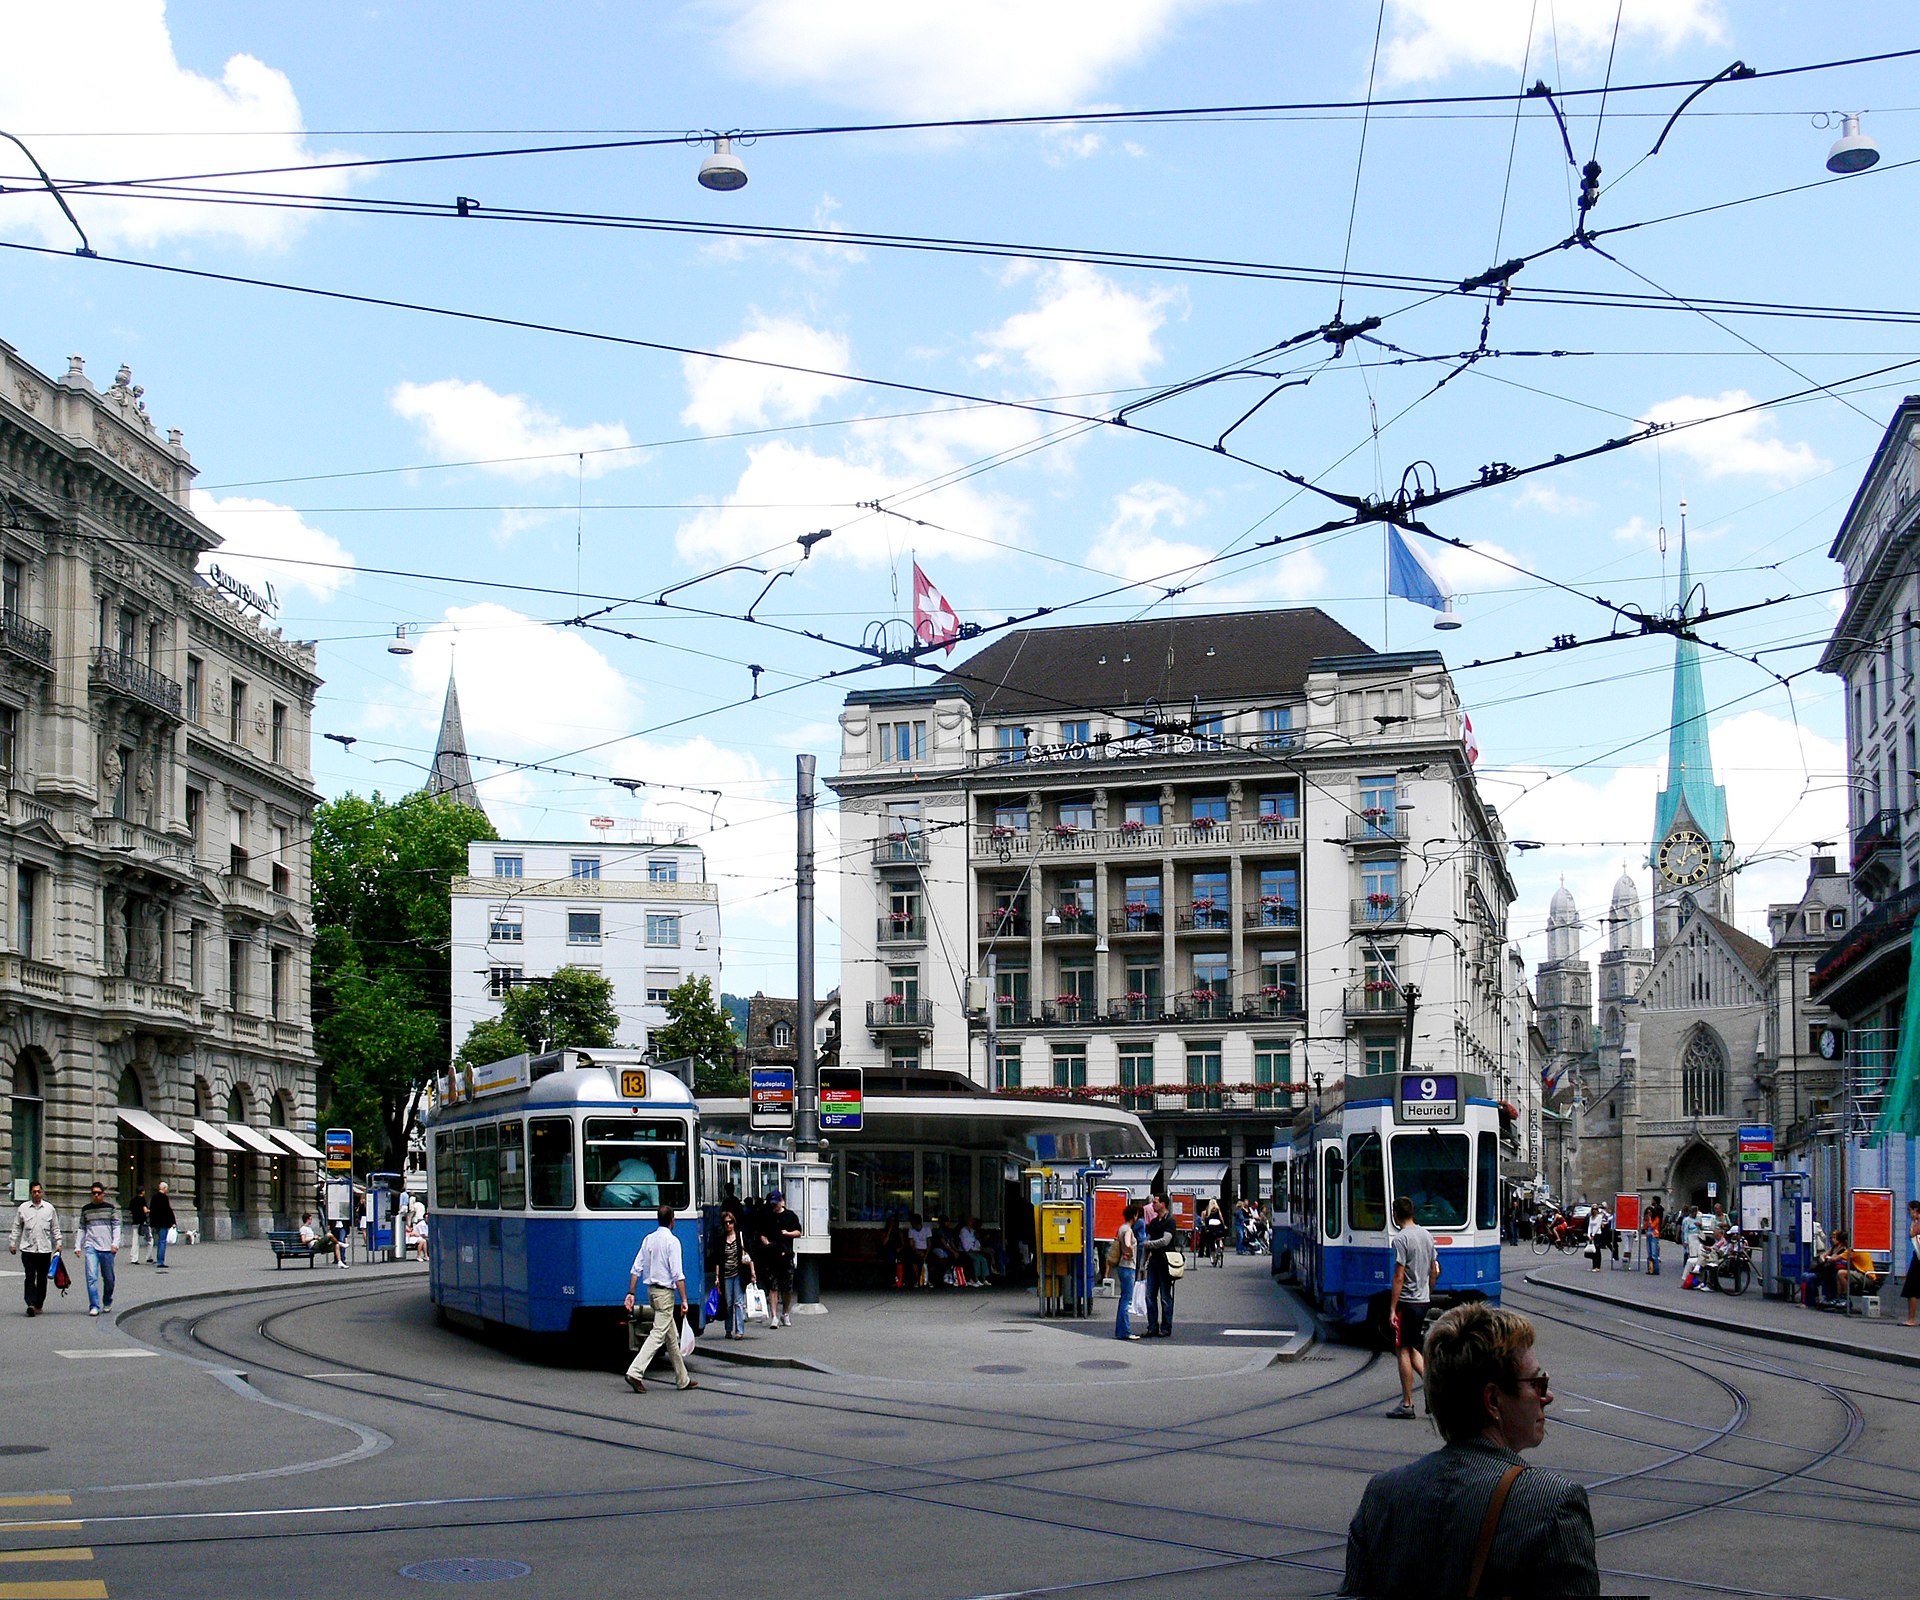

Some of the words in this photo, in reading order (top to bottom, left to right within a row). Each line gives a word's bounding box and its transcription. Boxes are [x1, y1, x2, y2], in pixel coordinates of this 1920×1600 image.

[1029, 743, 1095, 762] SAVOY
[1165, 734, 1231, 753] HOTEL
[624, 1076, 642, 1093] 13
[1420, 1078, 1437, 1100] 9
[758, 1092, 763, 1100] 6
[758, 1104, 763, 1112] 7
[1408, 1106, 1450, 1115] Heuried
[825, 1116, 831, 1124] 9
[1187, 1145, 1220, 1157] TÜRLER
